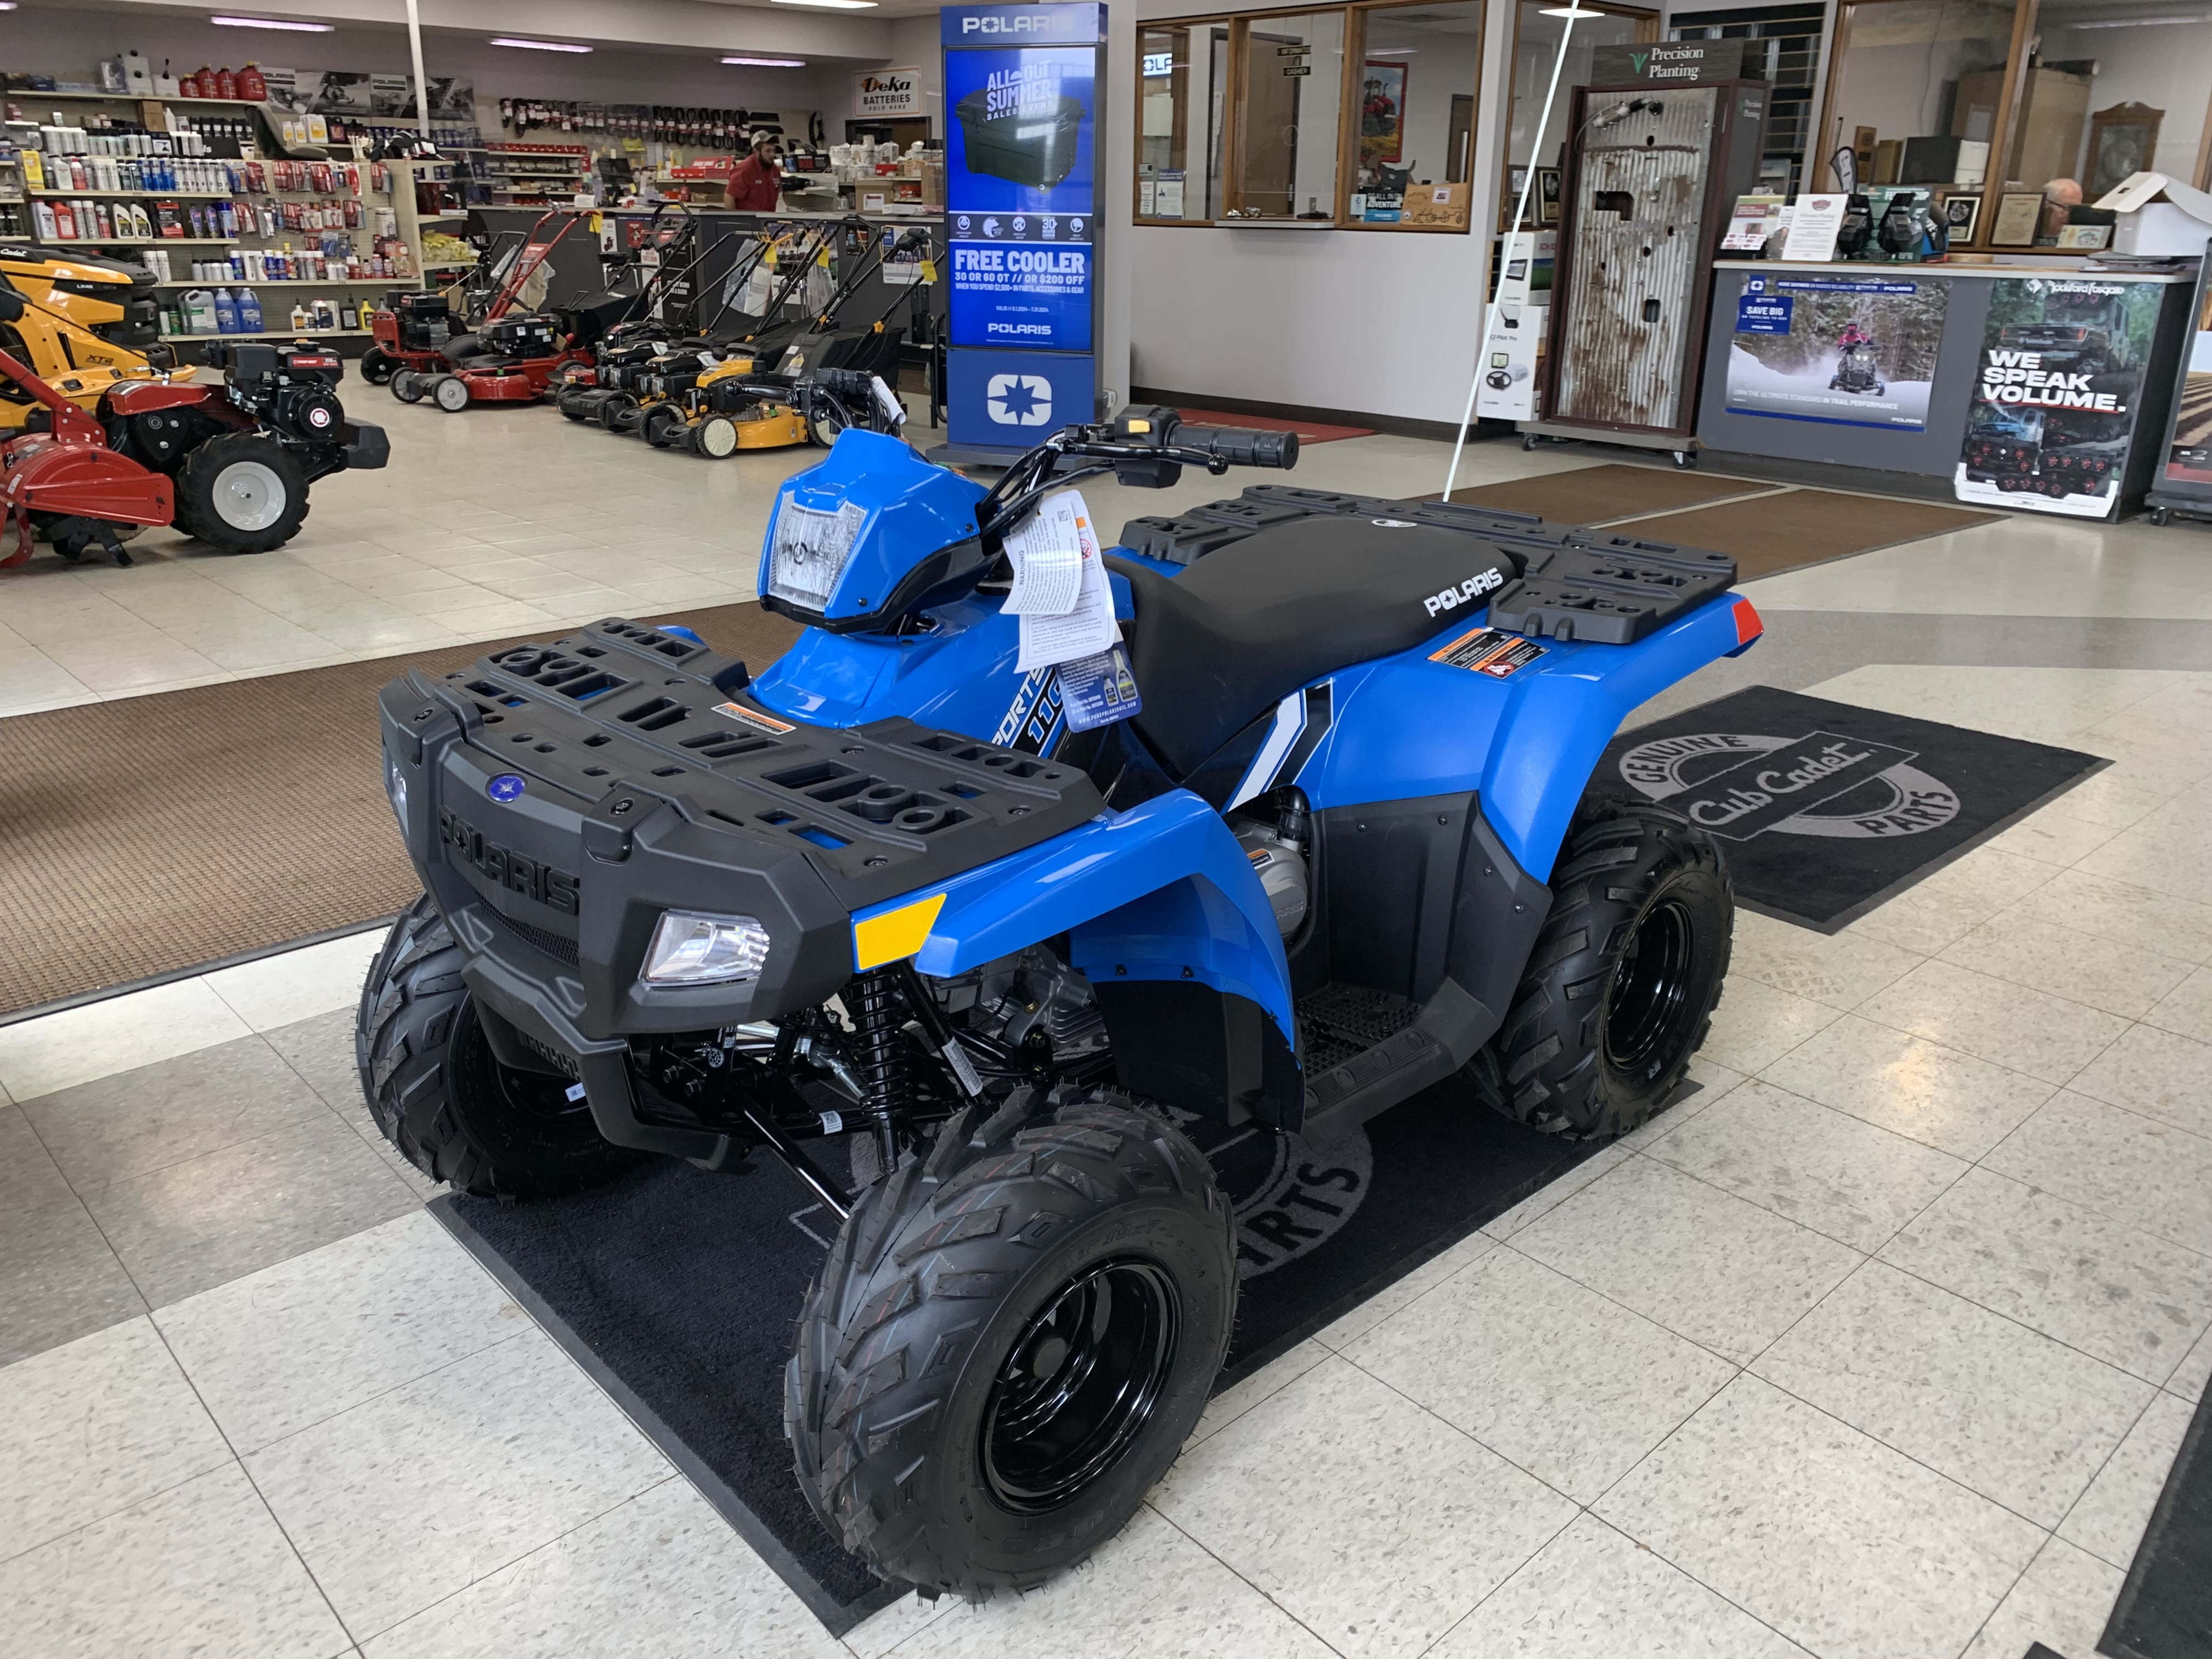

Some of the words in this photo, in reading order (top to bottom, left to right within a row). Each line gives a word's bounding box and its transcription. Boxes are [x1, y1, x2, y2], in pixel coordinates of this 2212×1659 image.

[1651, 46, 1703, 60] Precision
[987, 69, 1011, 92] ALL
[1023, 59, 1052, 82] OUT
[1649, 64, 1700, 81] Planting
[863, 76, 911, 93] Deka
[864, 94, 910, 105] BATTERIES
[987, 81, 1052, 112] SUMMER
[986, 108, 1018, 121] SALES
[1, 248, 27, 257] Cadet
[955, 250, 1004, 271] FREE
[1007, 251, 1085, 274] COOLER
[955, 272, 967, 281] 30
[969, 273, 981, 281] OR
[983, 273, 995, 282] 60
[997, 273, 1010, 283] QT
[1024, 274, 1037, 284] OR
[1040, 274, 1064, 284] $200
[1066, 275, 1085, 285] OFF
[1746, 306, 1769, 315] SAVE
[1769, 307, 1784, 316] BIG
[988, 323, 1052, 335] POLARIS
[86, 354, 114, 364] XT2
[1989, 350, 2041, 369] WE
[1984, 366, 2094, 391] SPEAK
[1831, 398, 1849, 406] TRAIL
[1850, 399, 1899, 410] PERFORMANCE
[1982, 383, 2126, 413] VOLUME.
[1424, 567, 1503, 618] POLARIS
[1626, 735, 1749, 783] GENUINE
[1689, 787, 1773, 825] Cub
[1756, 742, 1872, 794] Cadet
[1853, 790, 1954, 835] PARTS
[438, 804, 580, 916] POLARIS
